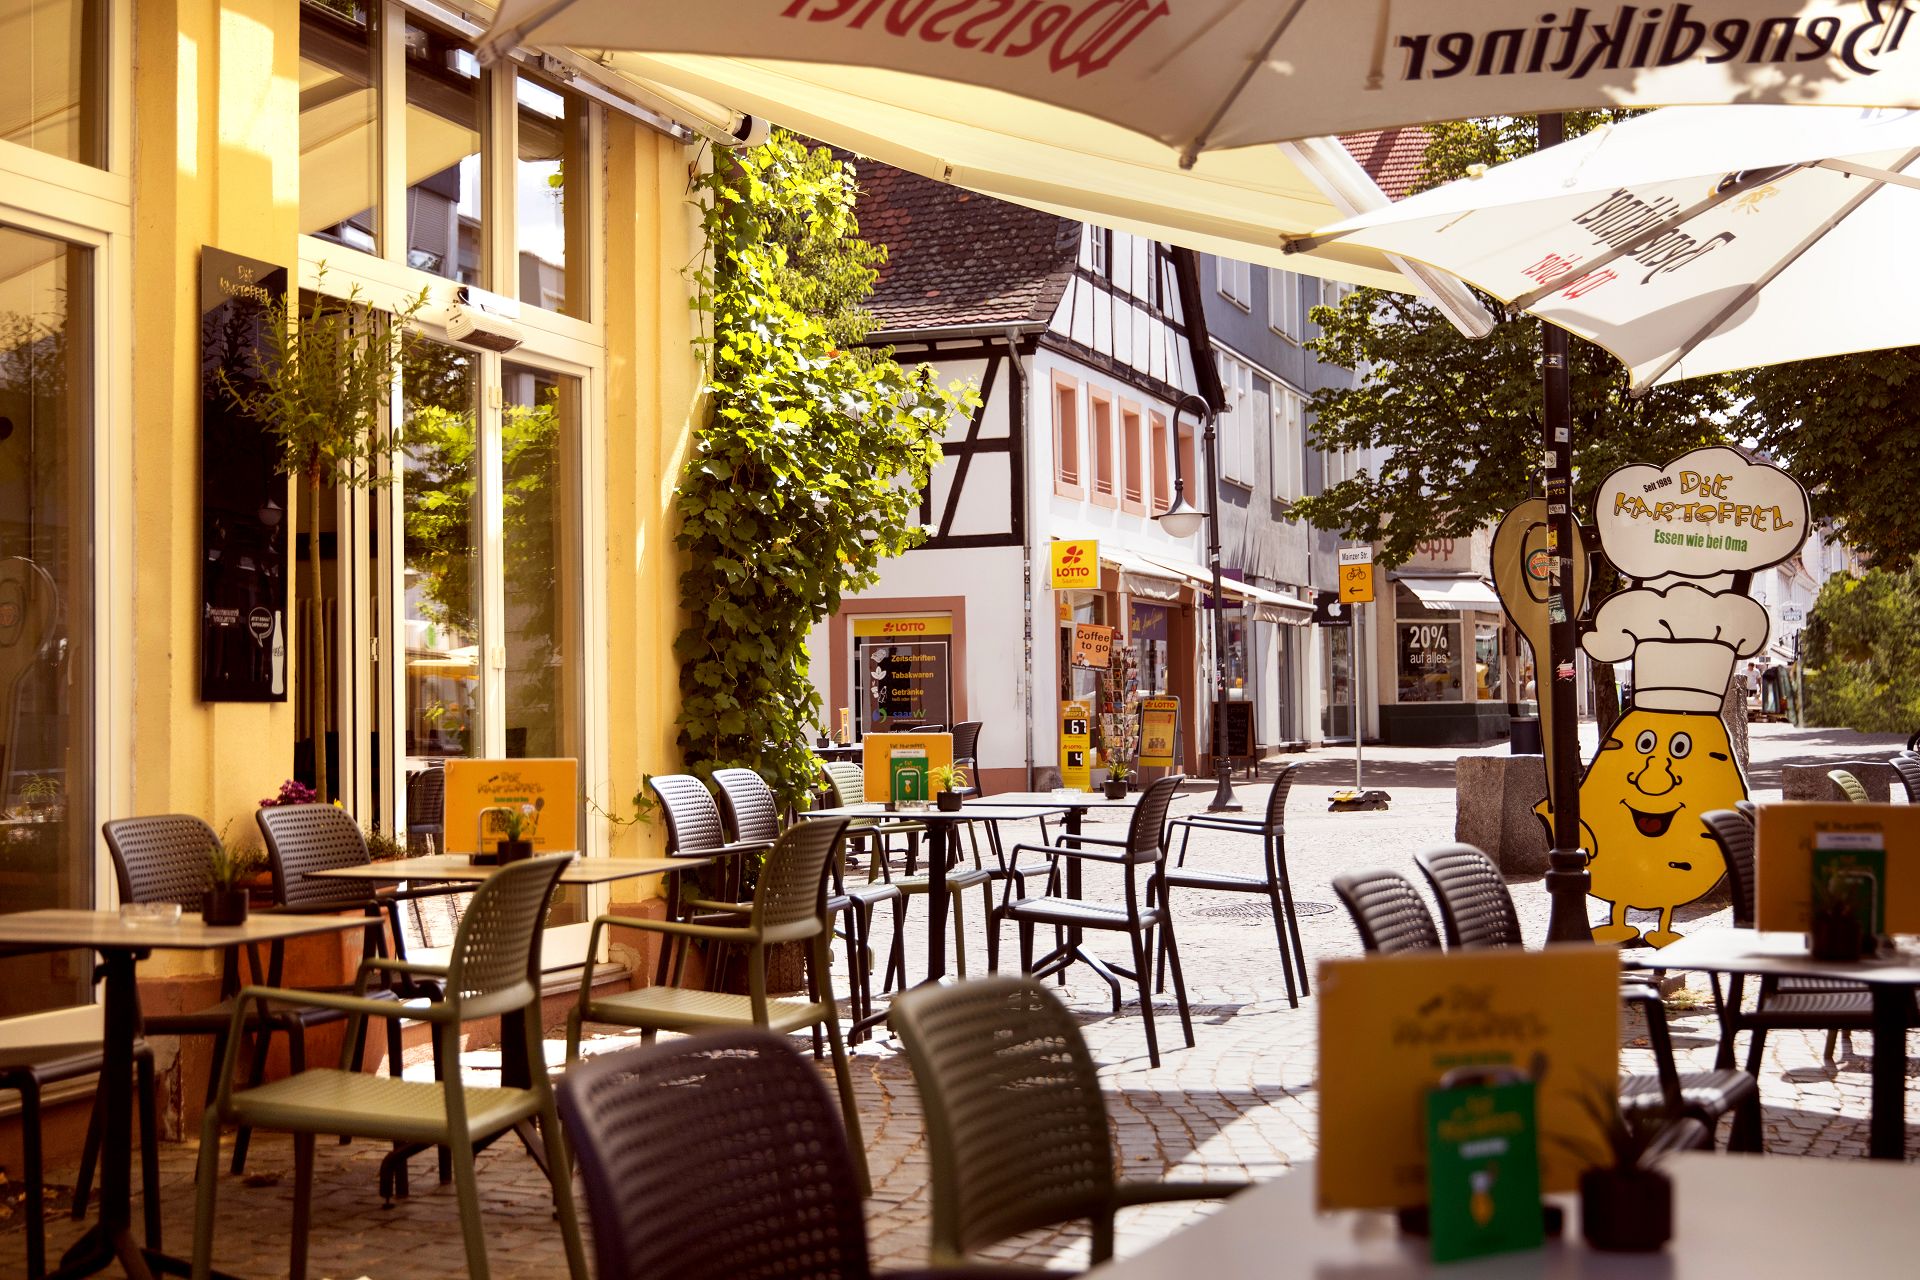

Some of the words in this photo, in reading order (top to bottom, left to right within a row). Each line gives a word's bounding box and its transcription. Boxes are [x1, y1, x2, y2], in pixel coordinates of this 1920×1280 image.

[1643, 481, 1657, 493] Seit
[1656, 476, 1673, 490] 1989
[1613, 491, 1794, 532] KARTOFFEL
[1653, 528, 1684, 546] Essen
[1686, 532, 1704, 548] wie
[1706, 533, 1723, 550] bei
[1725, 536, 1748, 552] Oma
[1342, 552, 1360, 560] Mainzer
[1360, 551, 1369, 559] Str.
[1056, 567, 1089, 577] LOTTO
[895, 622, 926, 632] LOTTO
[1076, 630, 1110, 642] Coffee
[1410, 625, 1447, 648] 20%
[1081, 642, 1092, 650] to
[1095, 645, 1109, 653] go
[891, 654, 936, 663] Zeitschriften
[1410, 651, 1424, 664] auf
[892, 671, 934, 679] Tabakwaren
[891, 688, 925, 696] Getränke
[1153, 701, 1176, 709] LOTTO
[1074, 752, 1083, 766] 4
